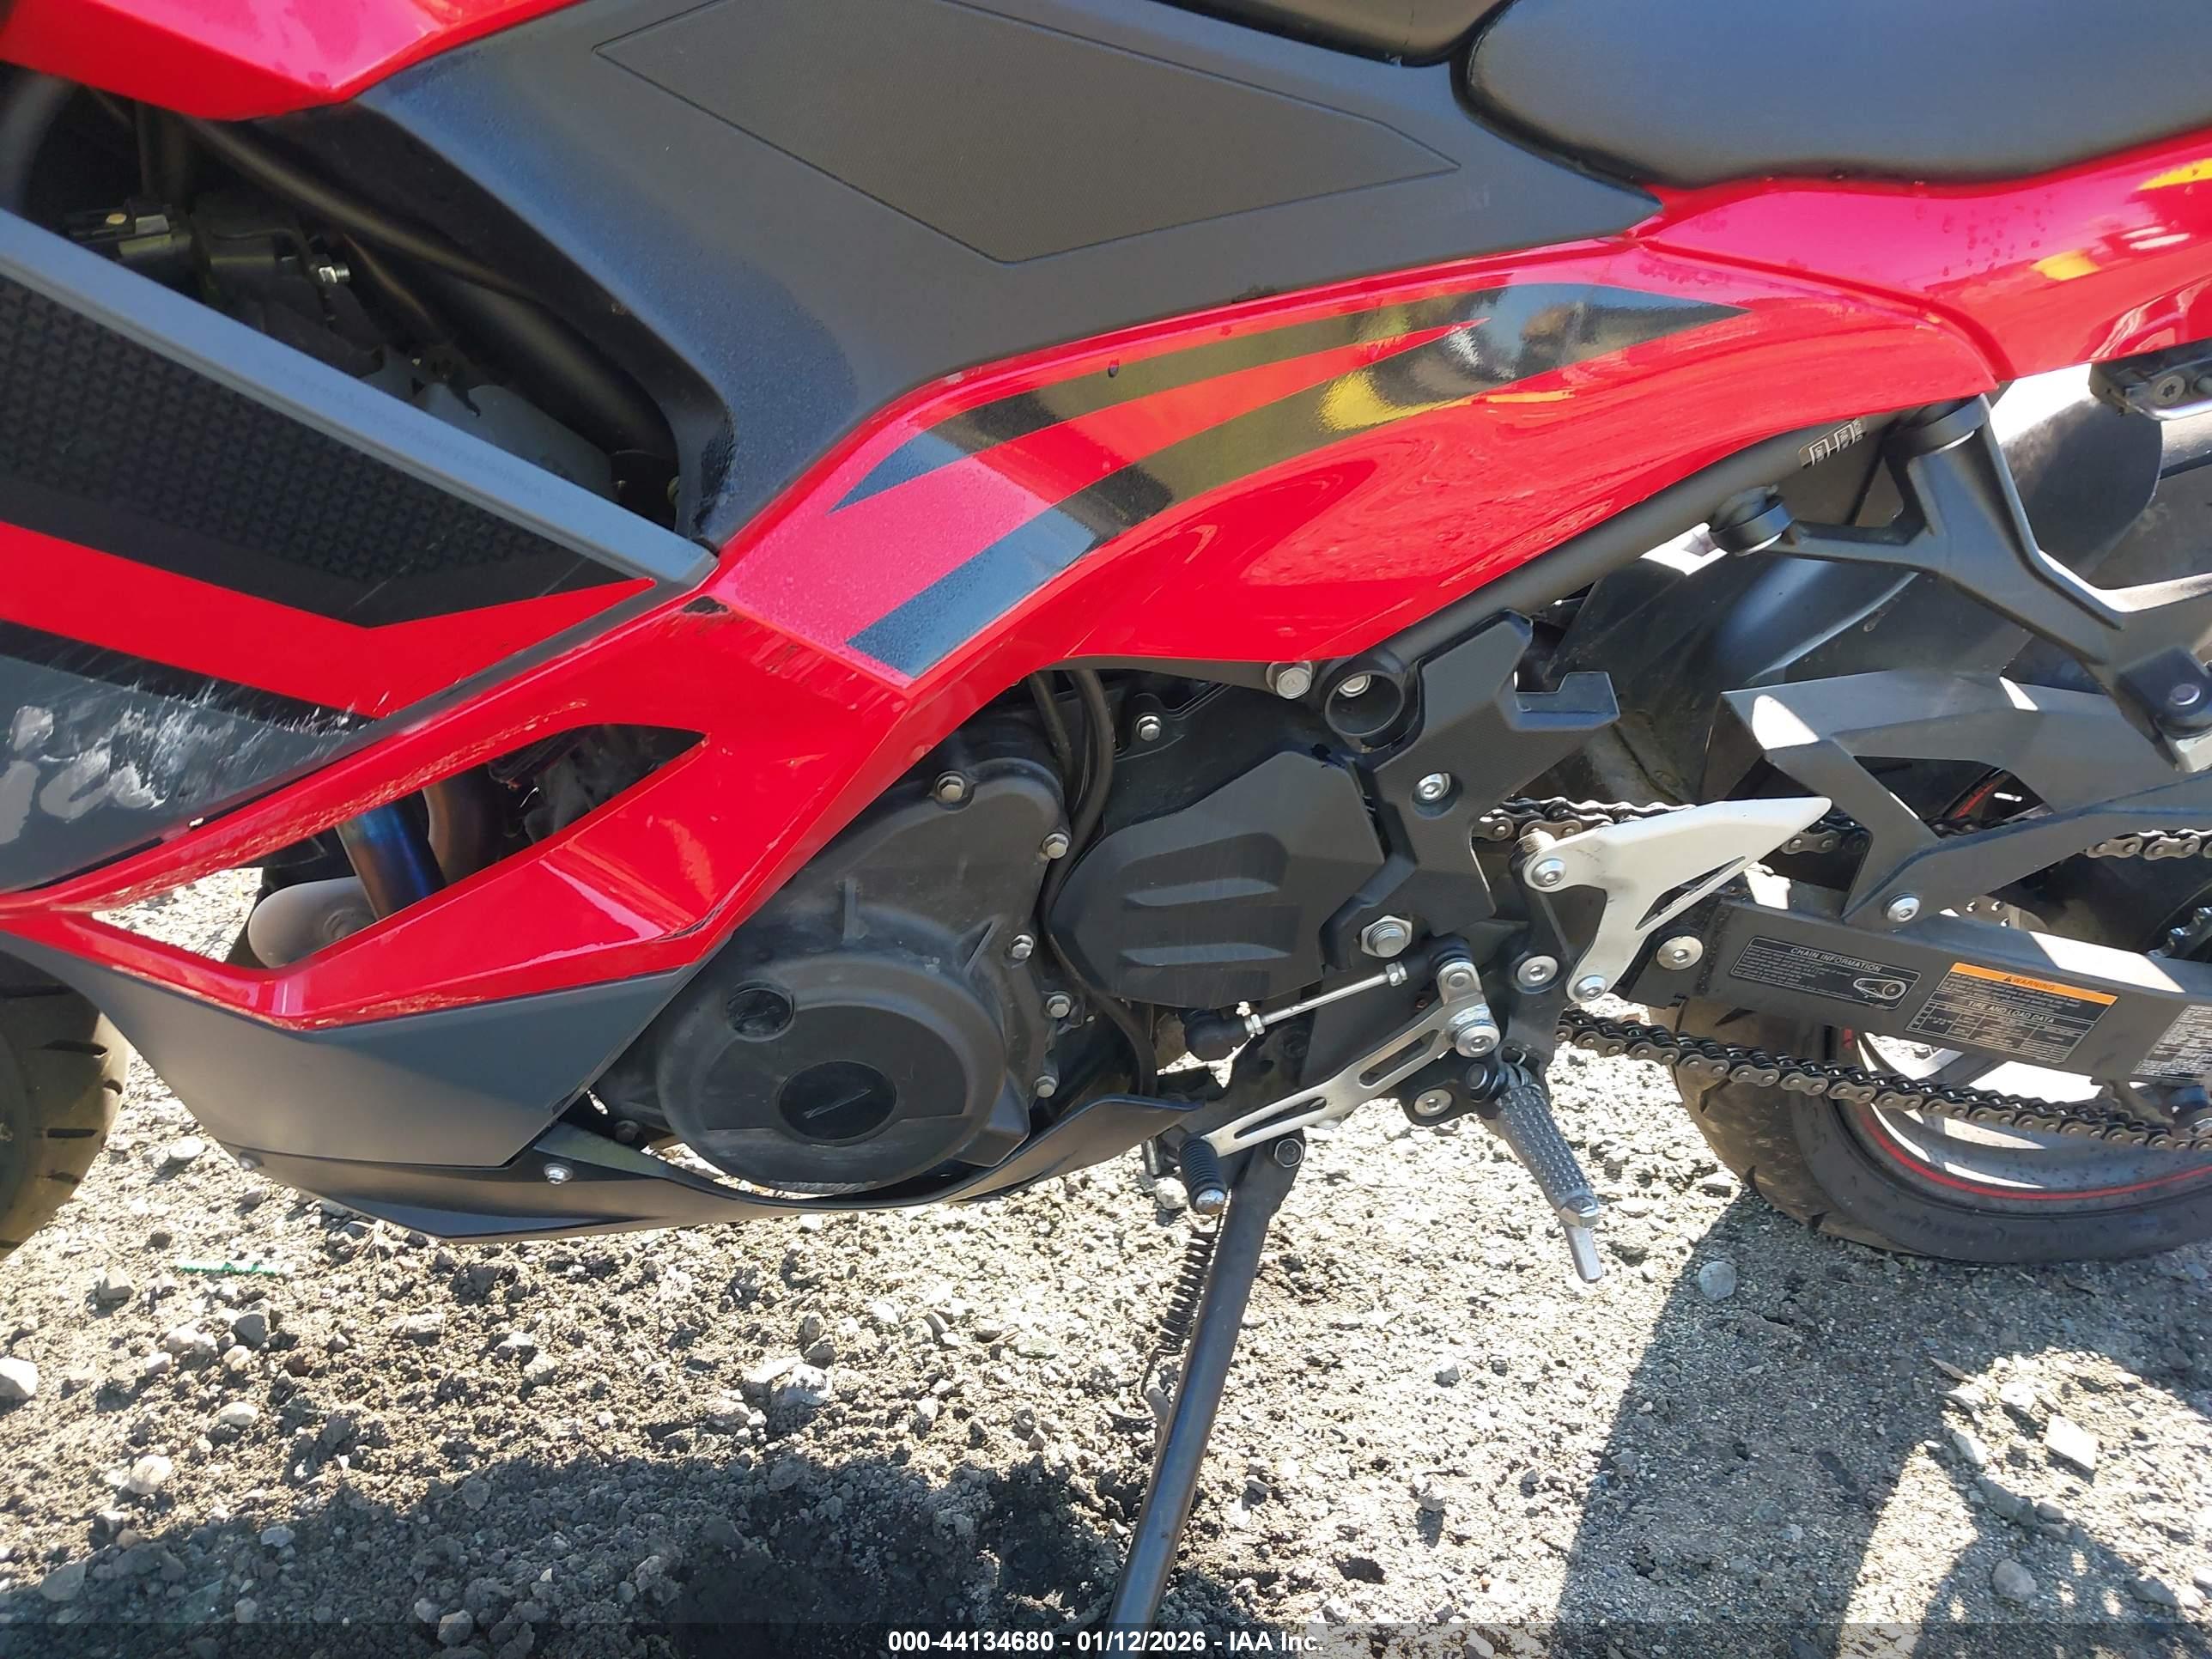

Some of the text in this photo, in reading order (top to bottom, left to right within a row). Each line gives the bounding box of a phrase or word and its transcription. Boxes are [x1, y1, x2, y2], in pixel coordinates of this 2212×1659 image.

[1790, 947, 1882, 973] CHAIN INFORMATION
[2014, 977, 2055, 991] WARNING
[1968, 1000, 2055, 1024] TIRE AND LOAD DATA
